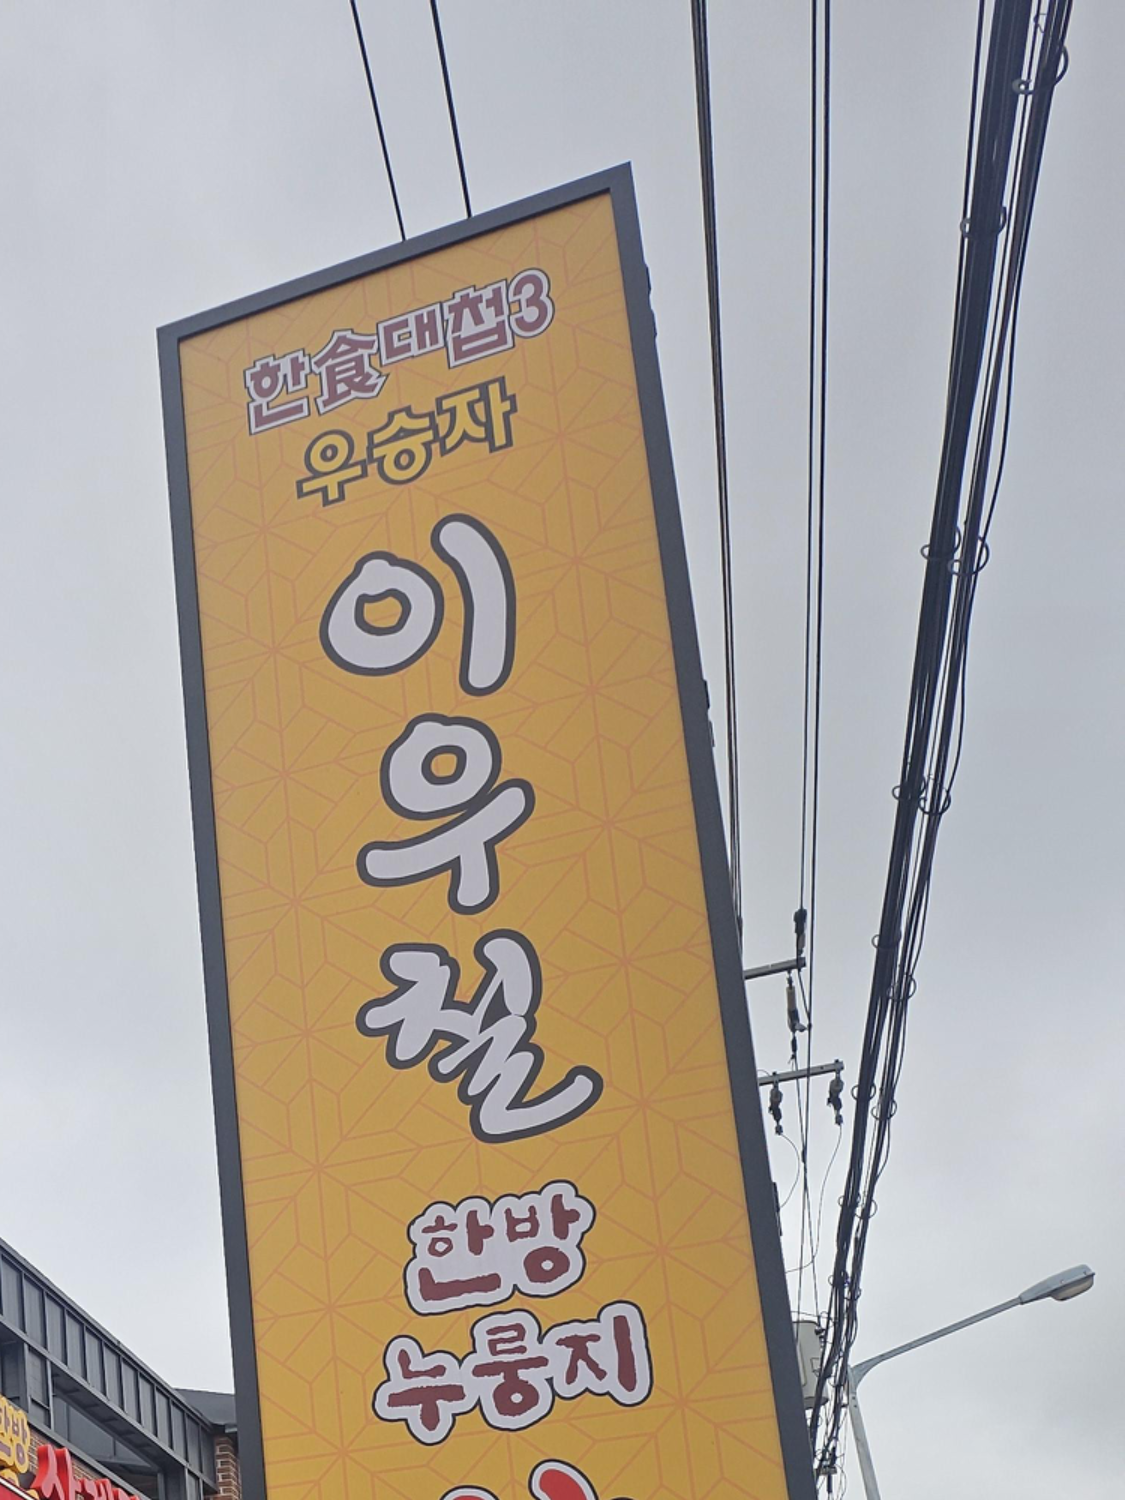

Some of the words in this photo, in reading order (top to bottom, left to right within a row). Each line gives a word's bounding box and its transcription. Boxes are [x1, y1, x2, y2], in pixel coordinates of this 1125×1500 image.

[244, 269, 555, 435] 한食대첩3
[297, 376, 518, 507] 우승자
[319, 513, 604, 1144] 이우철
[408, 1183, 591, 1312] 한방
[377, 1305, 647, 1441] 누룽지
